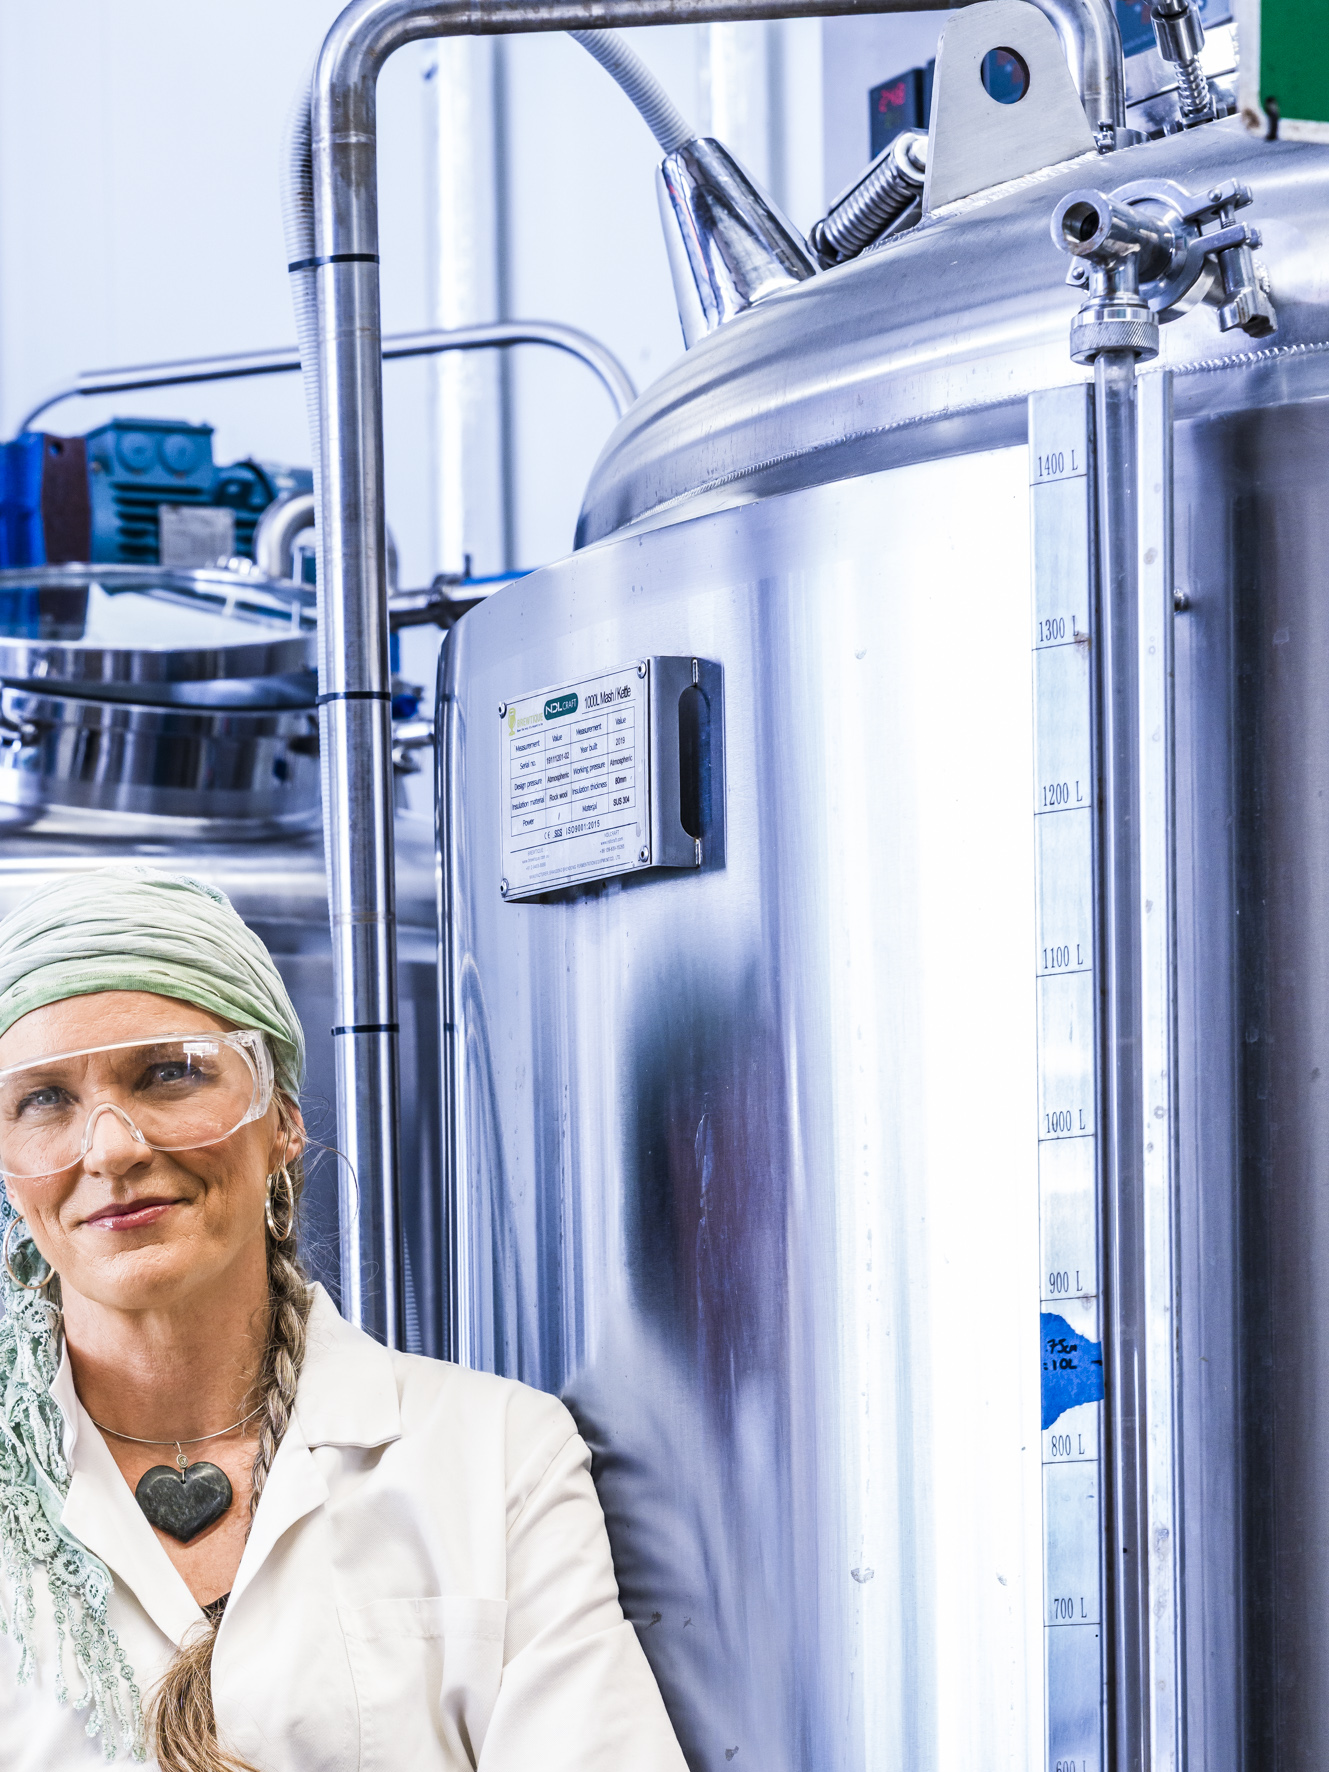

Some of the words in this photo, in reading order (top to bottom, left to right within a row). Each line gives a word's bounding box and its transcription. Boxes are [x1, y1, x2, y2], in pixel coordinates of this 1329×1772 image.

[1038, 451, 1064, 477] 1400
[1071, 449, 1078, 471] L
[1039, 617, 1065, 642] 1300
[1072, 615, 1080, 637] L
[584, 693, 600, 709] 1000L
[615, 716, 626, 725] Value
[576, 723, 602, 736] Measurement
[552, 734, 562, 742] Value
[615, 736, 625, 746] 2019
[515, 740, 540, 752] Measurement
[589, 742, 598, 751] built
[520, 760, 529, 770] Serial
[610, 754, 633, 767] Atmospheric
[573, 766, 589, 775] Working
[590, 762, 605, 772] pressure
[547, 771, 570, 783] Atmospheric
[615, 776, 627, 785] 80mm
[514, 782, 526, 791] Design
[527, 778, 542, 789] pressure
[572, 785, 589, 795] Insulation
[590, 781, 608, 791] thickness
[549, 793, 559, 802] Rock
[559, 790, 568, 799] wool
[622, 795, 630, 804] 304
[1043, 782, 1069, 806] 1200
[1076, 780, 1083, 802] L
[512, 801, 529, 810] Insulation
[530, 795, 545, 806] material
[582, 801, 597, 812] Material
[522, 818, 535, 827] Power
[1043, 945, 1070, 969] 1100
[1077, 943, 1084, 965] L
[1046, 1110, 1072, 1133] 1000
[1079, 1108, 1086, 1130] L
[1049, 1271, 1069, 1294] 900
[1076, 1270, 1083, 1291] L
[1051, 1434, 1071, 1457] 800
[1078, 1433, 1085, 1455] L
[1054, 1597, 1074, 1620] 700
[1080, 1597, 1087, 1618] L
